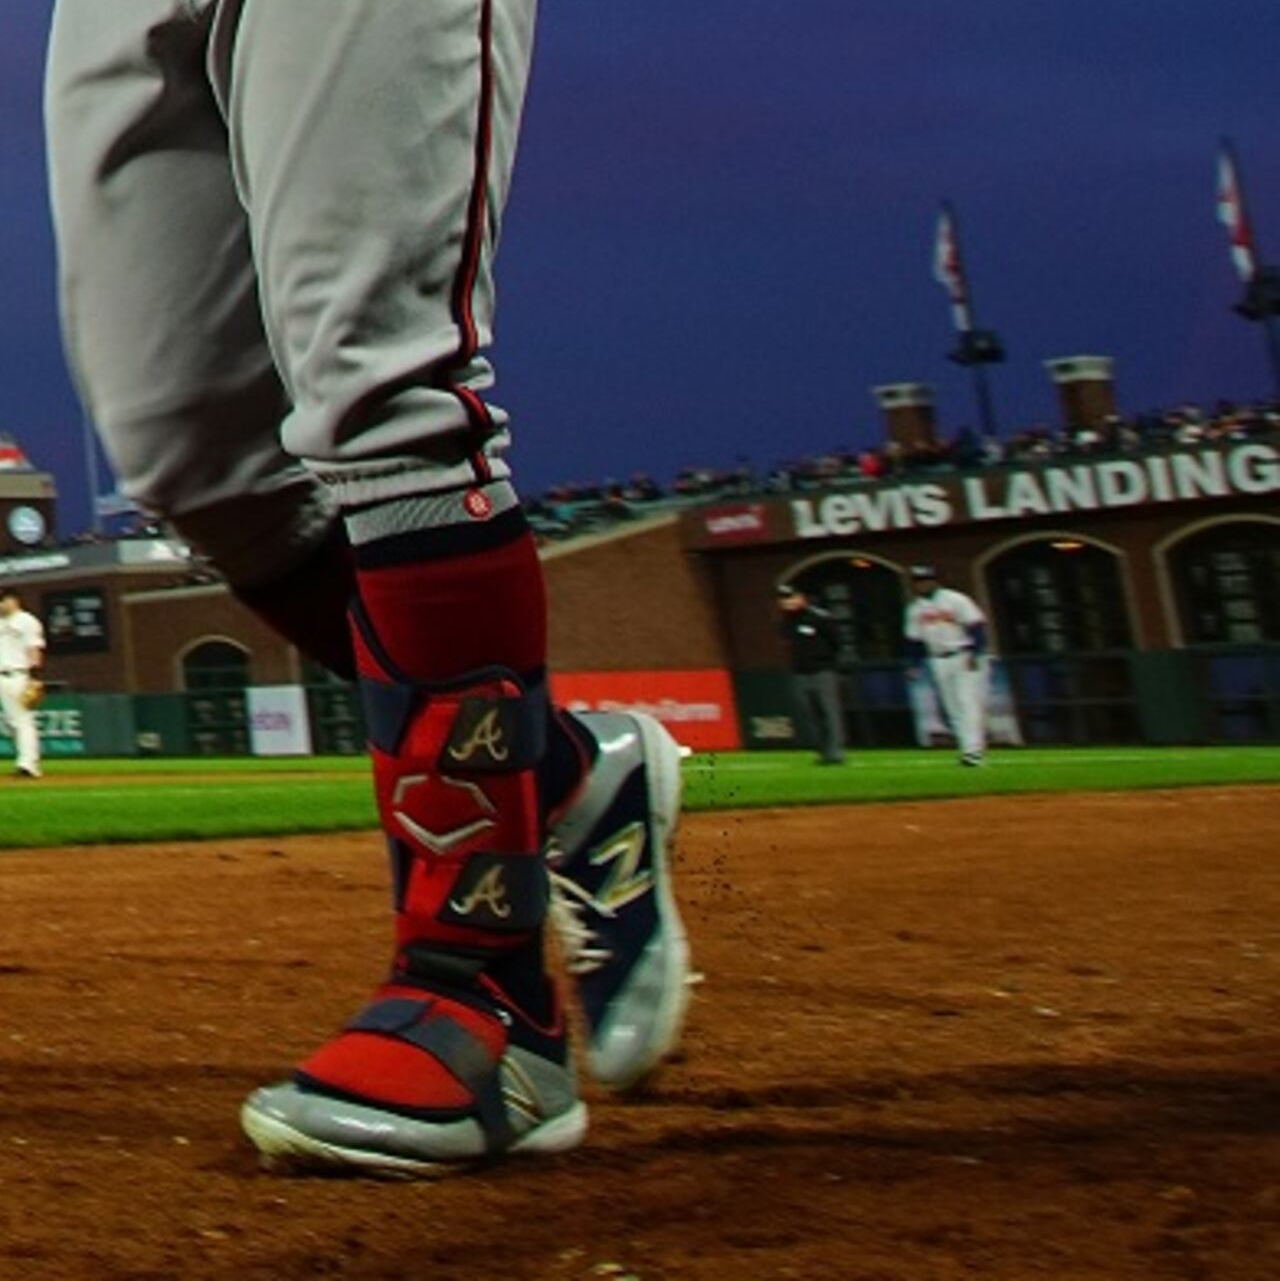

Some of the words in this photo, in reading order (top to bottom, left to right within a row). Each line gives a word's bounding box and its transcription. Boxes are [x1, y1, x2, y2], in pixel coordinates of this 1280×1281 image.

[963, 444, 1280, 519] LANDING
[450, 707, 509, 762] A
[450, 864, 511, 918] A
